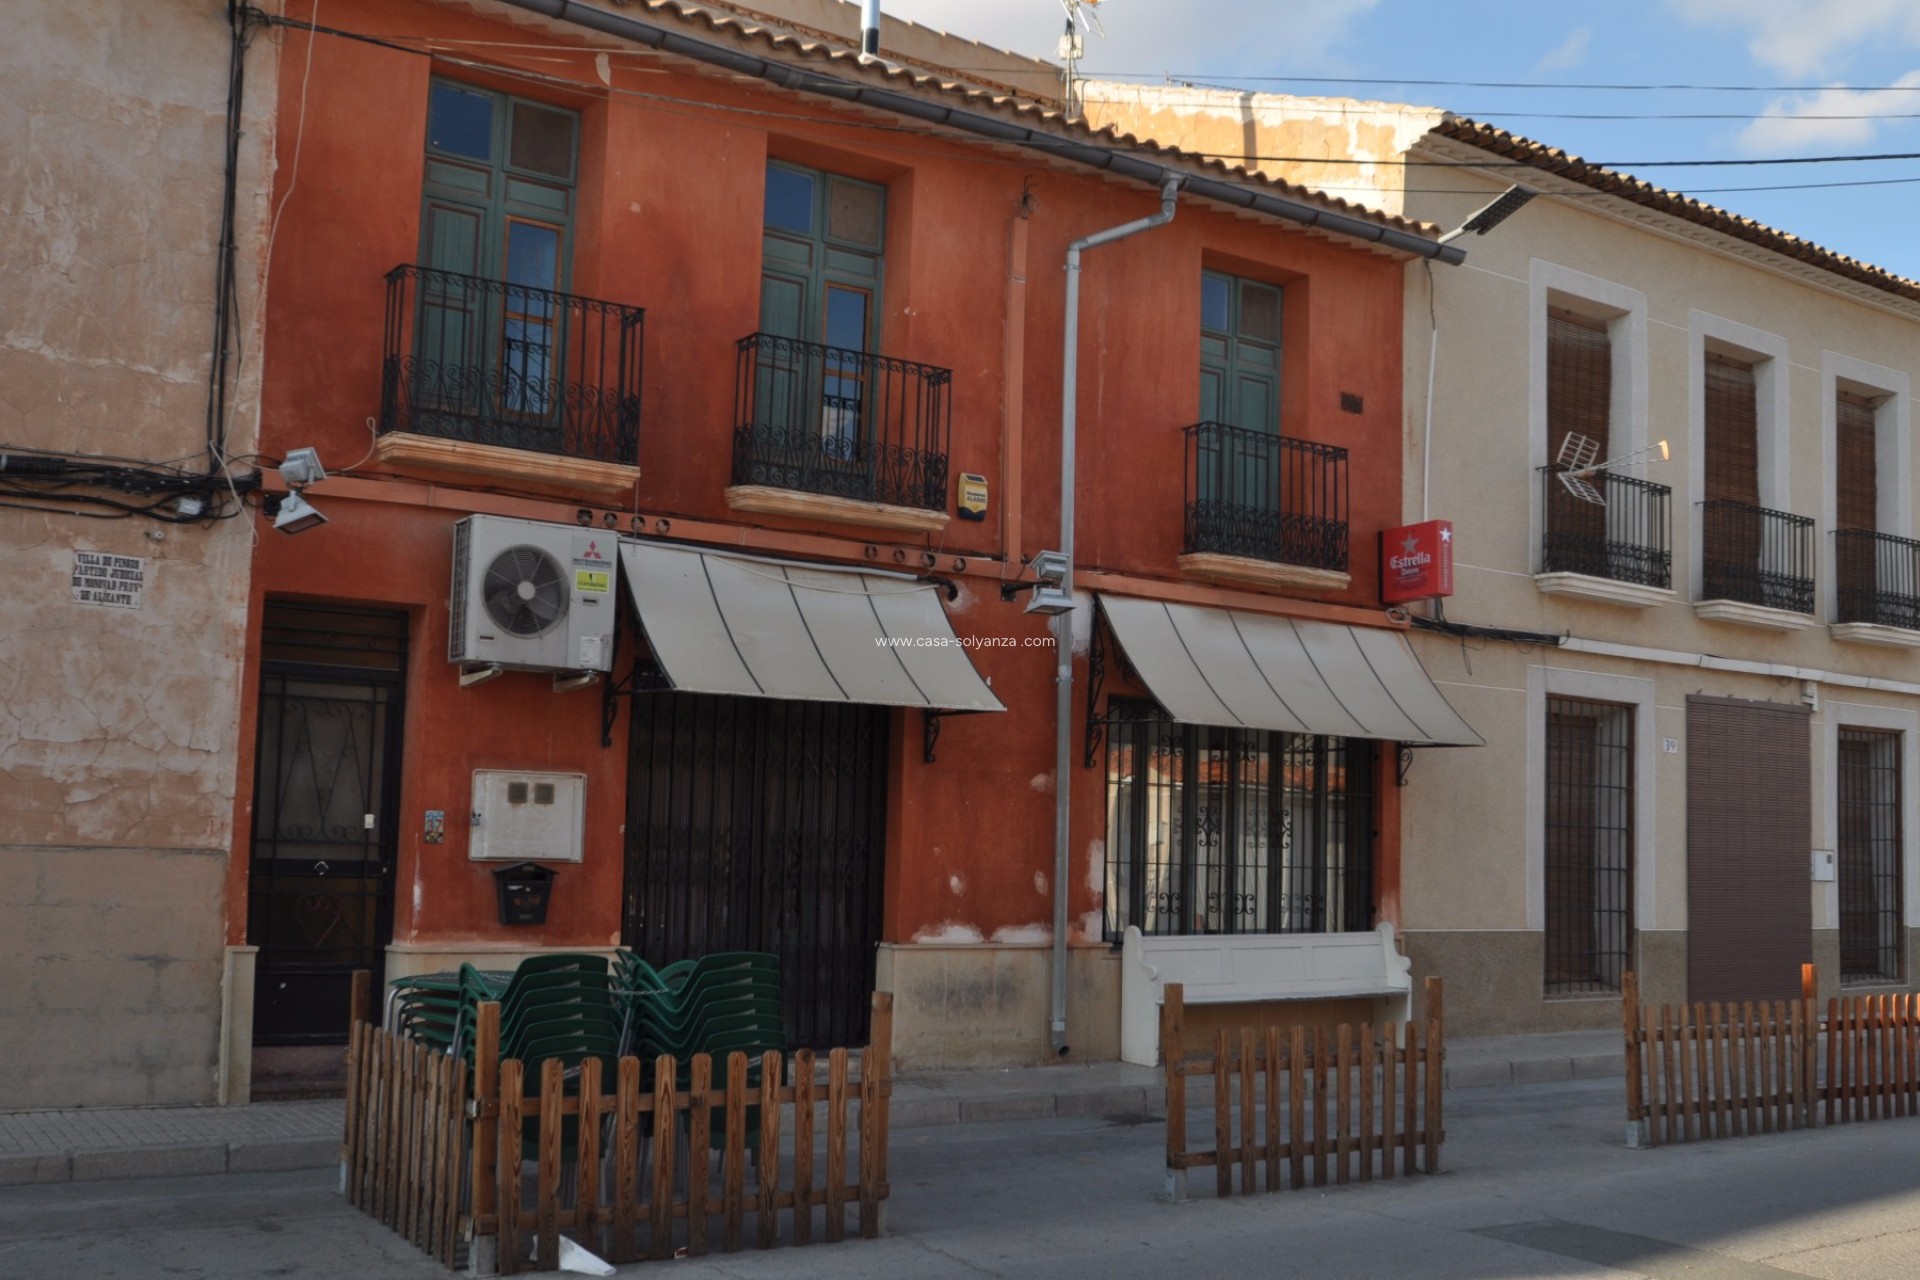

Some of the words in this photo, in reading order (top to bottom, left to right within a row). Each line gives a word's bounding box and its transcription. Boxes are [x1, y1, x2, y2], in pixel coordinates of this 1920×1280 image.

[77, 553, 100, 565] VILLA
[102, 556, 112, 566] DE
[1390, 551, 1431, 569] Estrella
[110, 568, 143, 581] JUDICIAL
[72, 577, 82, 587] DE
[80, 590, 91, 601] DE
